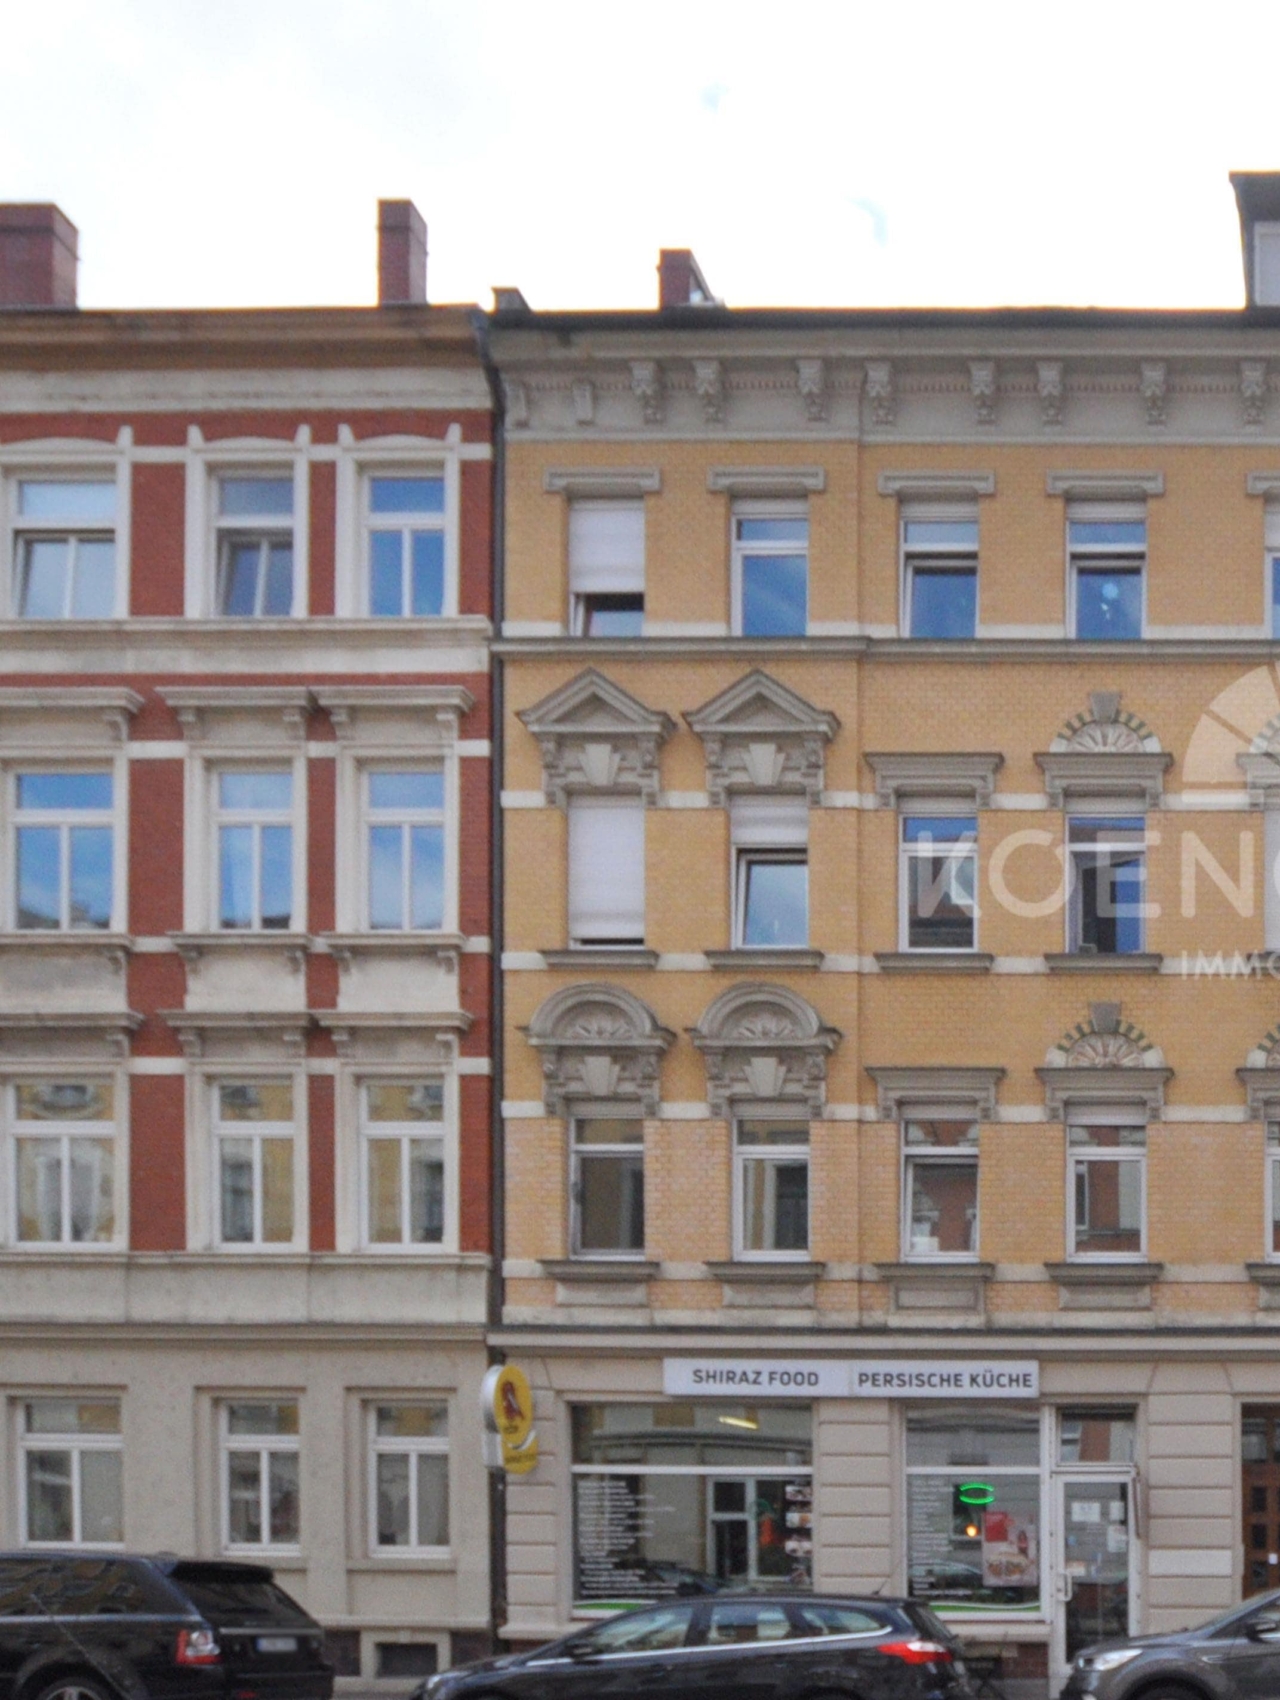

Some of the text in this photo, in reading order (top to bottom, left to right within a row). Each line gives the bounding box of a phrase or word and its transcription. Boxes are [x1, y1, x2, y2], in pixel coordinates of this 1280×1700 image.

[693, 1369, 819, 1387] SHIRAZ FOOD
[858, 1369, 1033, 1388] PERSISCHE KÜCHE
